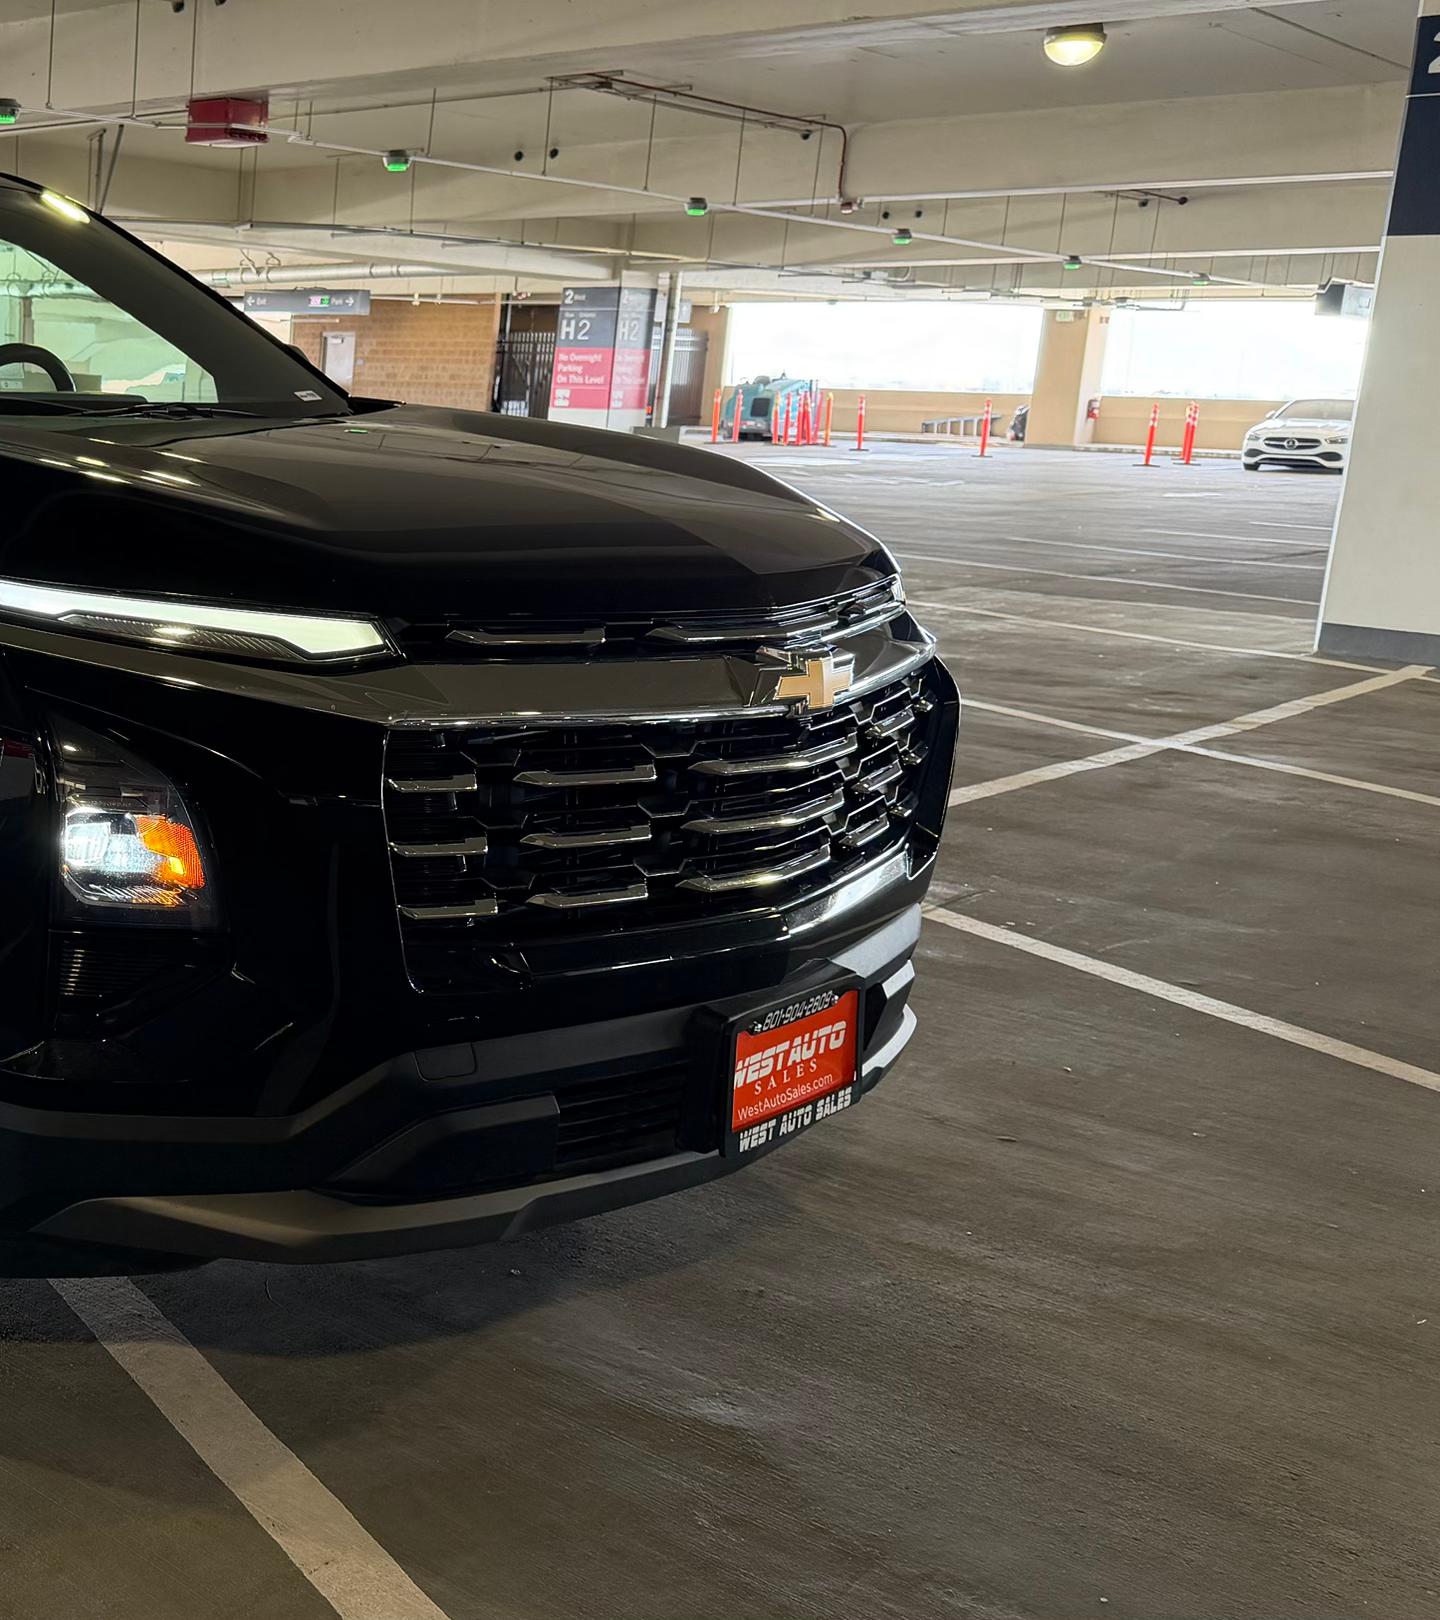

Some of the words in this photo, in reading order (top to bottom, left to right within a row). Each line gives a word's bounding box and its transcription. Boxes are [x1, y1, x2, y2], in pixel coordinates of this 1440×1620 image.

[564, 290, 574, 304] 2
[561, 320, 590, 340] H2
[570, 352, 602, 363] Overnight
[558, 363, 584, 374] Parking
[558, 376, 568, 384] On
[569, 375, 584, 384] This
[585, 375, 605, 384] Level
[754, 1058, 818, 1096] SALES
[737, 1073, 833, 1121] WestAutoSales.com
[739, 1119, 777, 1153] WEST
[779, 1104, 812, 1137] AUTO
[815, 1086, 853, 1121] SALES
